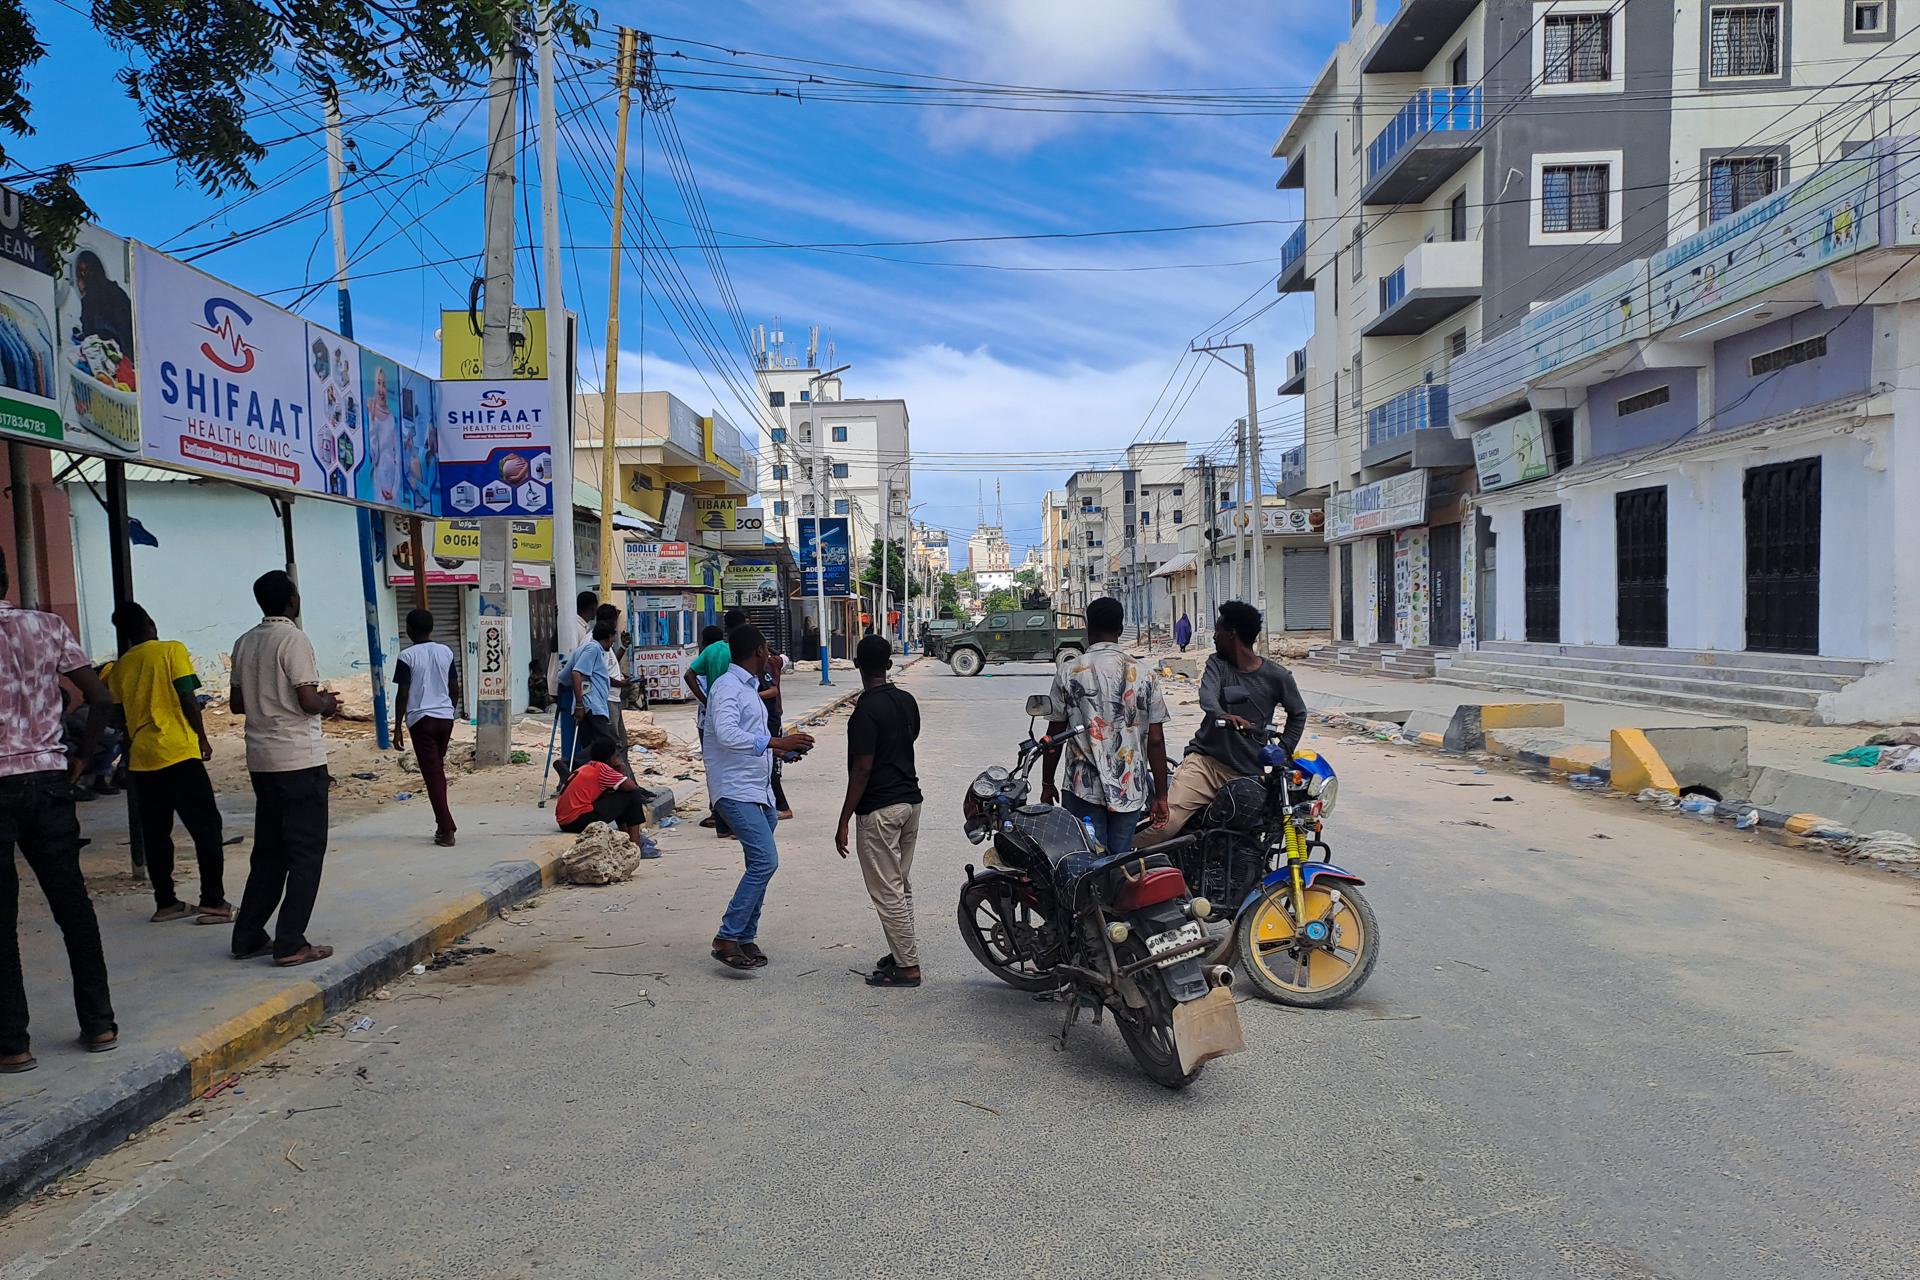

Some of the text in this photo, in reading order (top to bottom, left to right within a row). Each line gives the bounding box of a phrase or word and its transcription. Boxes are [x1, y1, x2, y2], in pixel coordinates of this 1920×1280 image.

[160, 361, 303, 440] SHIFAAT
[0, 412, 46, 433] 17834783
[448, 409, 541, 424] SHIFAAT
[463, 424, 497, 432] HEALTH
[188, 417, 290, 458] HEALTH CLINIC
[697, 500, 733, 510] LIBAAX
[482, 627, 500, 672] beco
[636, 652, 678, 661] JUMEYRA
